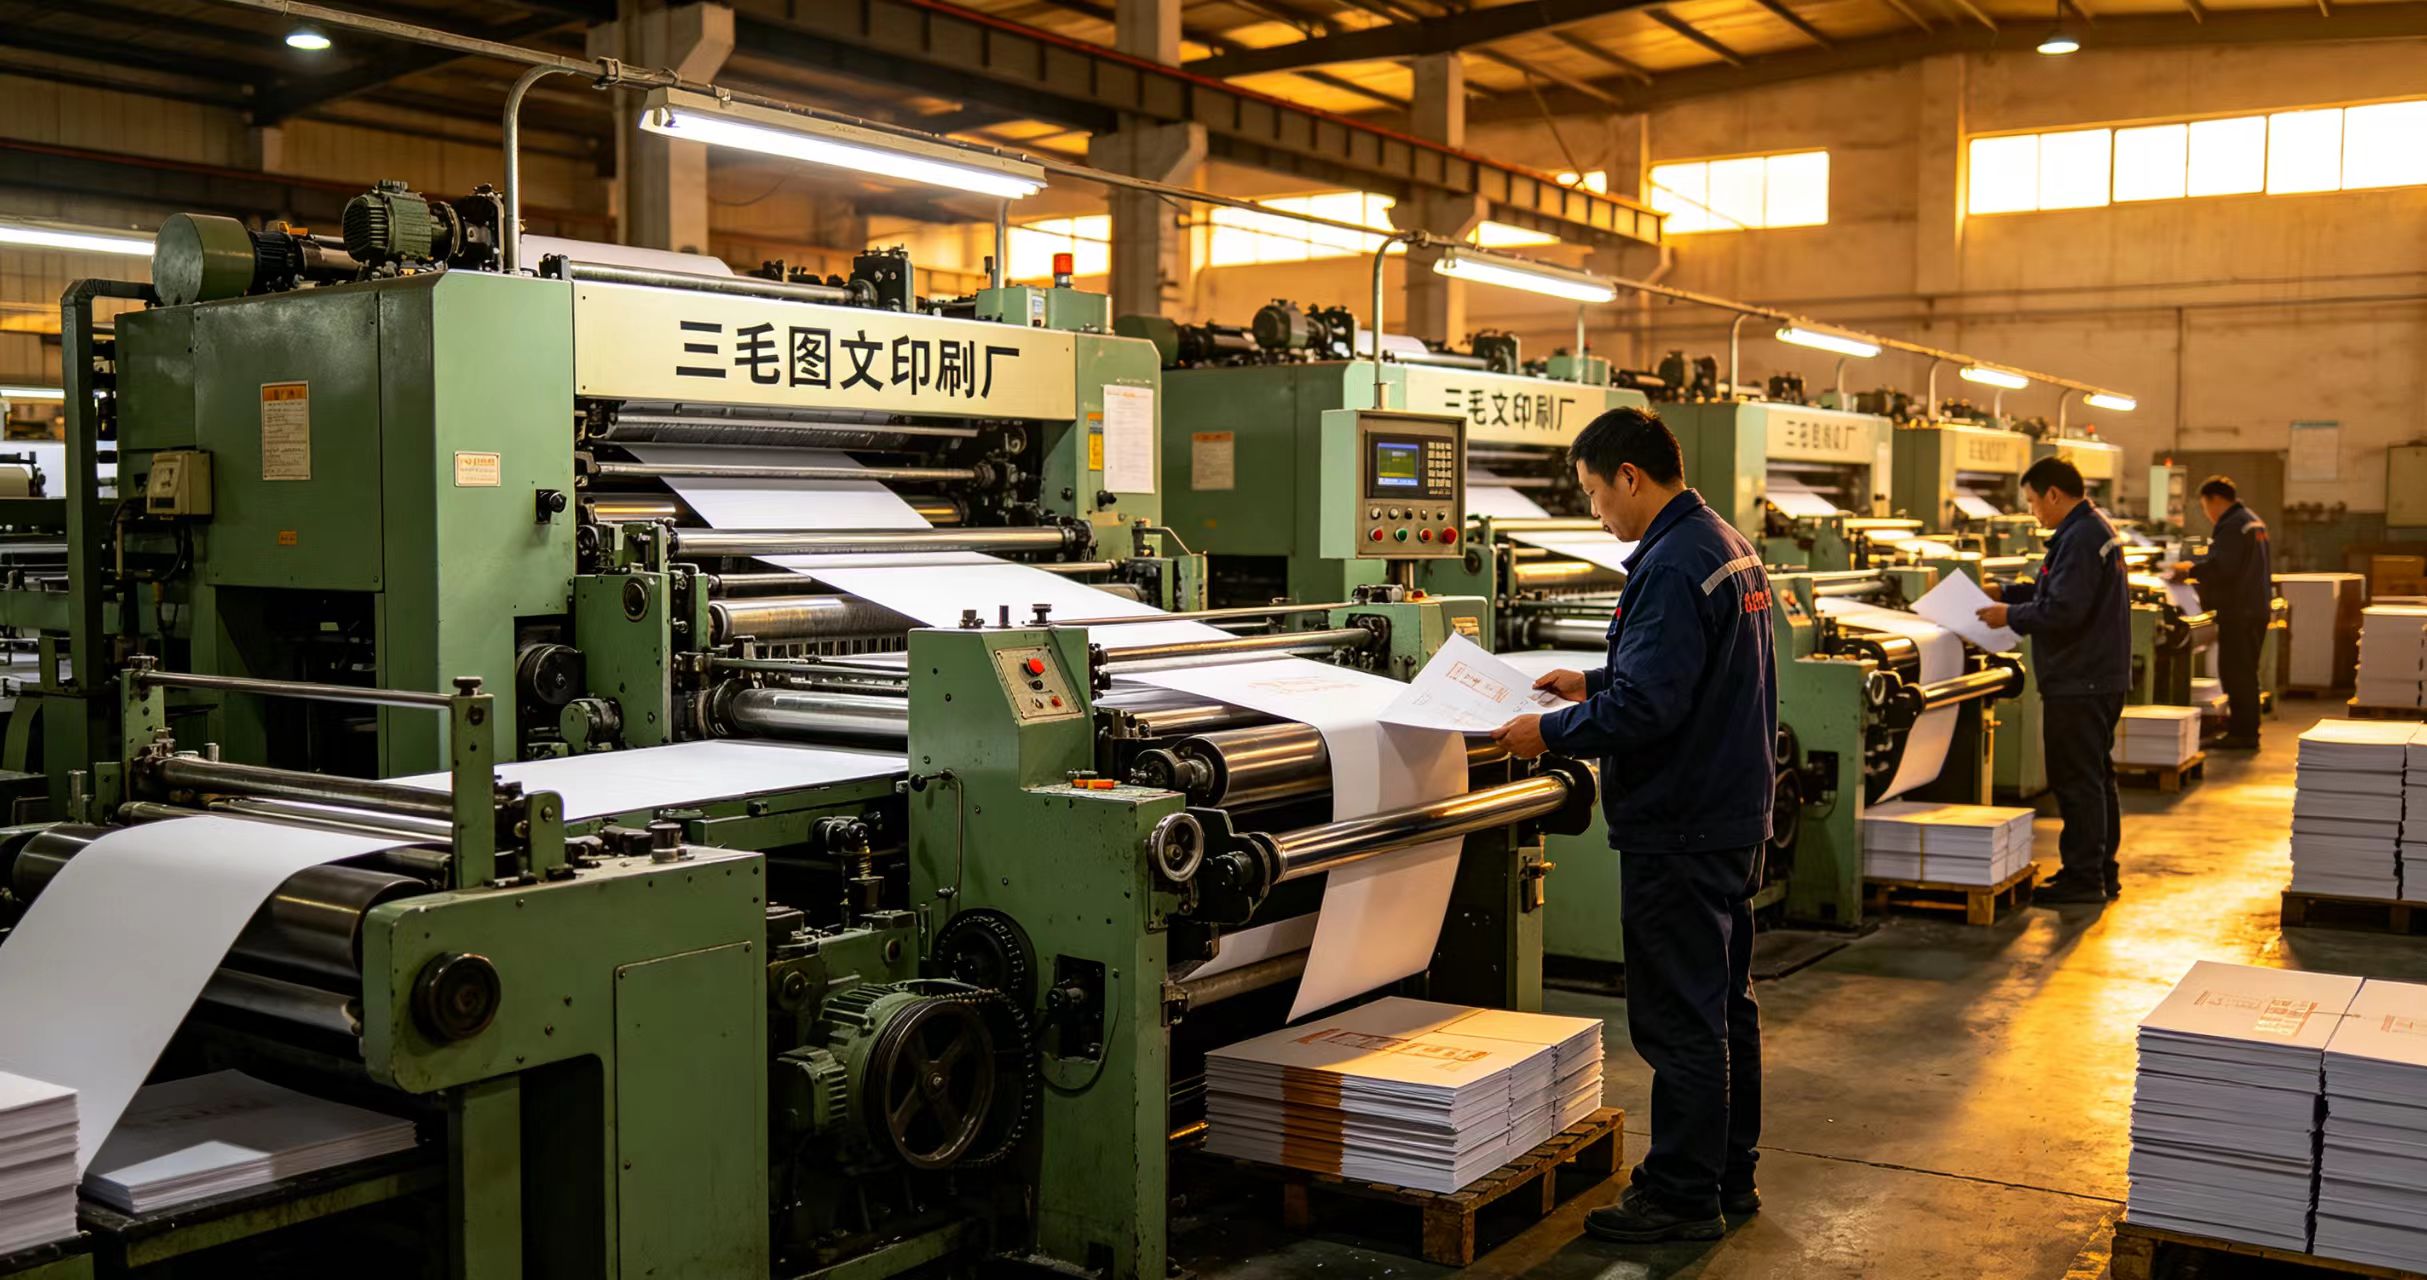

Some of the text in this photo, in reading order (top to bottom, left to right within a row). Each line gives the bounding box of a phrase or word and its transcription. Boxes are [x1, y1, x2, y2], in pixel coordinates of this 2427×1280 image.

[675, 319, 1020, 400] 三毛图文印刷厂
